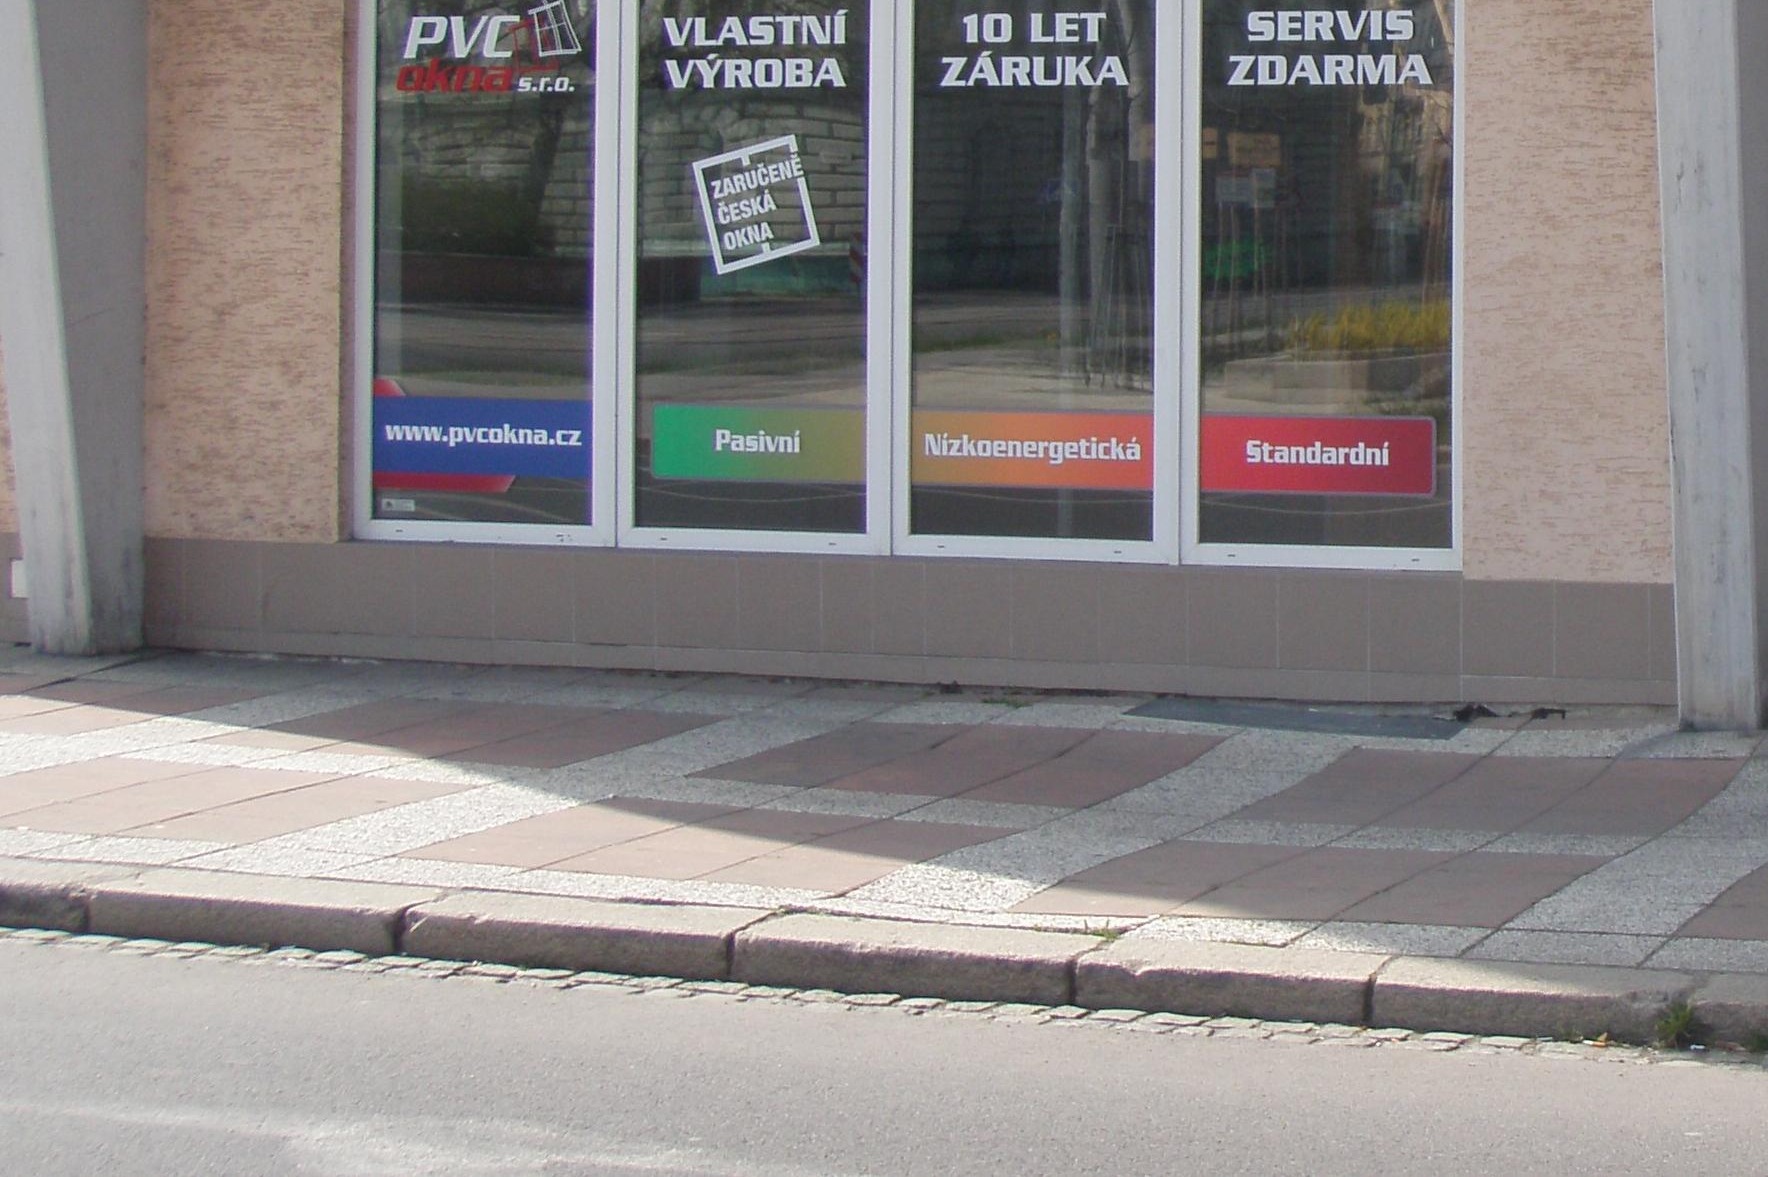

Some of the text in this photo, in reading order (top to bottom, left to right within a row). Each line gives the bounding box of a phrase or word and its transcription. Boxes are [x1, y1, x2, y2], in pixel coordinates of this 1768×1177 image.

[404, 16, 521, 59] PVC
[663, 10, 848, 47] VLASTNÍ
[962, 11, 1107, 43] 10 LET
[1247, 9, 1415, 42] SERVIS
[396, 59, 574, 93] okna s.r.o.
[664, 53, 847, 88] VÝROBA
[940, 51, 1129, 87] ZÁRUKA
[1227, 53, 1432, 86] ZDARMA
[711, 154, 804, 199] ZARUČENĚ
[718, 189, 776, 225] ČESKÁ
[723, 222, 774, 250] OKNA
[385, 423, 582, 448] www.pvcokna.cz
[715, 429, 801, 454] Pasivní
[924, 433, 1141, 465] Nízkoenergetická
[1246, 439, 1389, 466] Standardní
